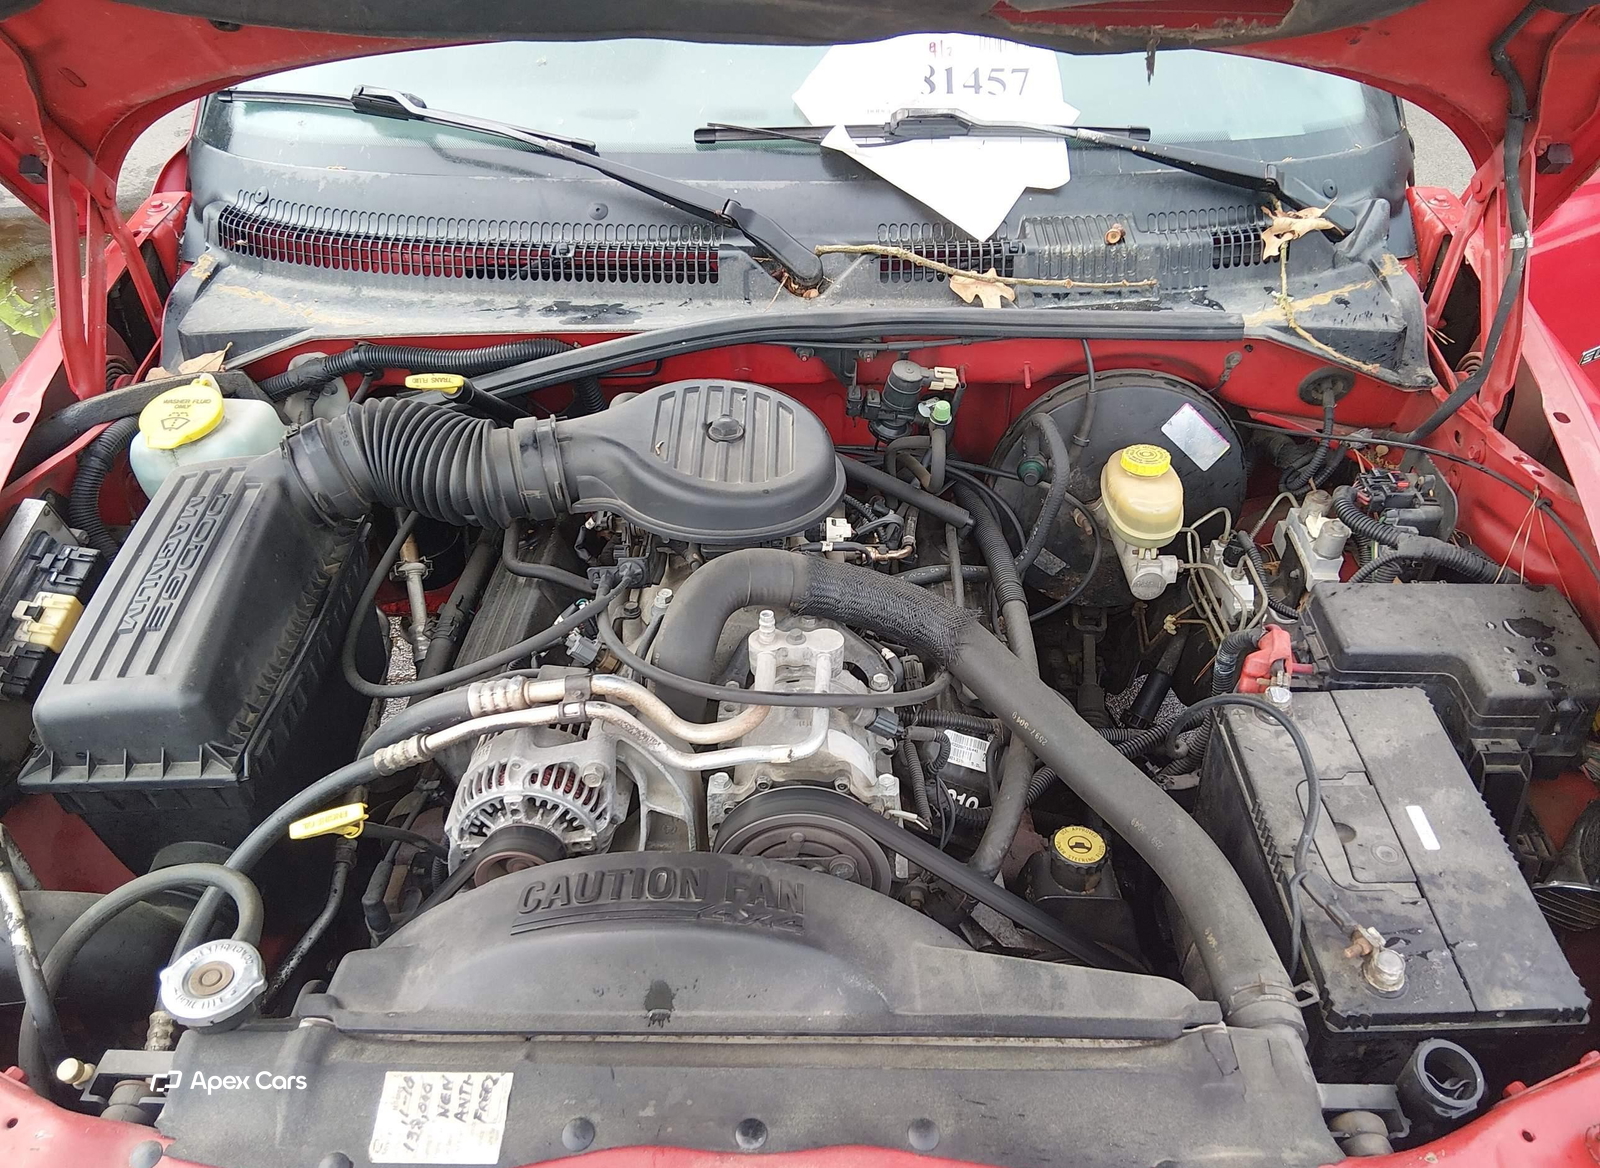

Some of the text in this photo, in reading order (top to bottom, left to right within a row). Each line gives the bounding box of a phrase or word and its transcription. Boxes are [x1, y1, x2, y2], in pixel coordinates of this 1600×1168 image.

[117, 495, 206, 635] MAGNUM
[145, 492, 232, 632] DODGE
[516, 866, 805, 915] CAUTION FAN
